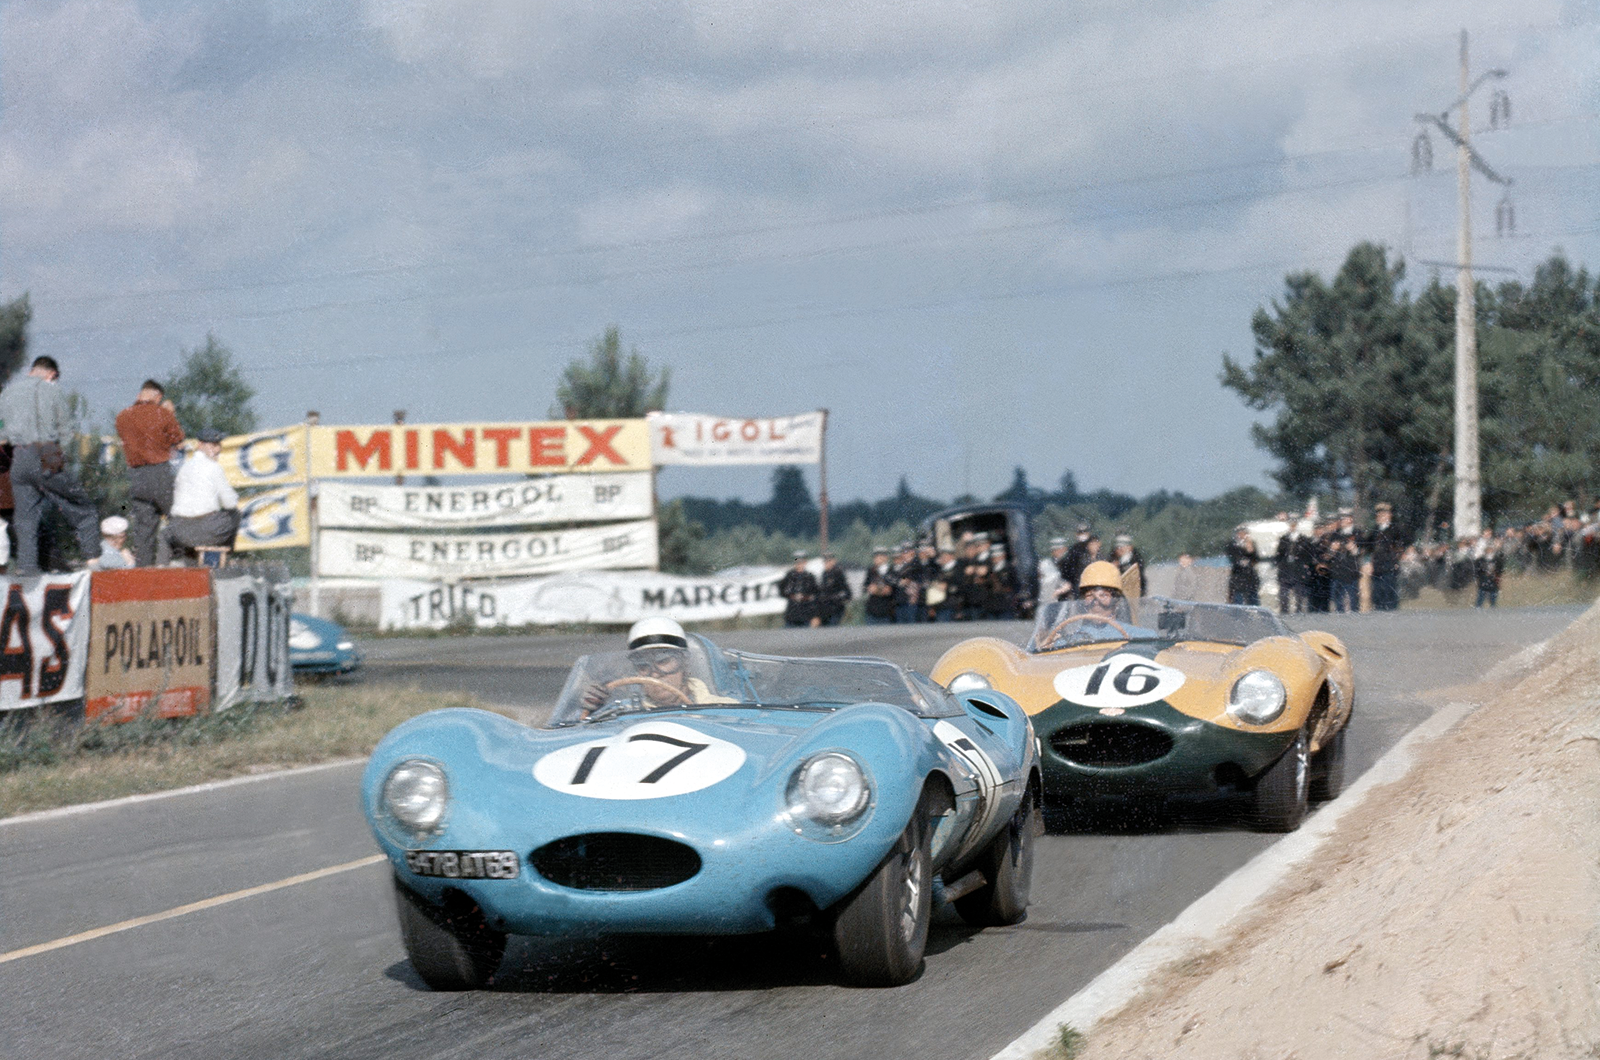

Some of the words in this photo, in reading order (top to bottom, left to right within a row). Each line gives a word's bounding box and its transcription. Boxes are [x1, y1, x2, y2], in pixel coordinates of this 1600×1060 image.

[696, 419, 785, 442] IGOL
[335, 424, 629, 472] MINTEX
[350, 495, 378, 513] BP
[404, 484, 563, 513] ENERGOL
[593, 485, 622, 504] BP
[356, 543, 384, 562] BP
[409, 536, 569, 562] ENERGOL
[602, 534, 631, 553] BP
[1084, 662, 1161, 696] 16
[569, 733, 710, 785] 17
